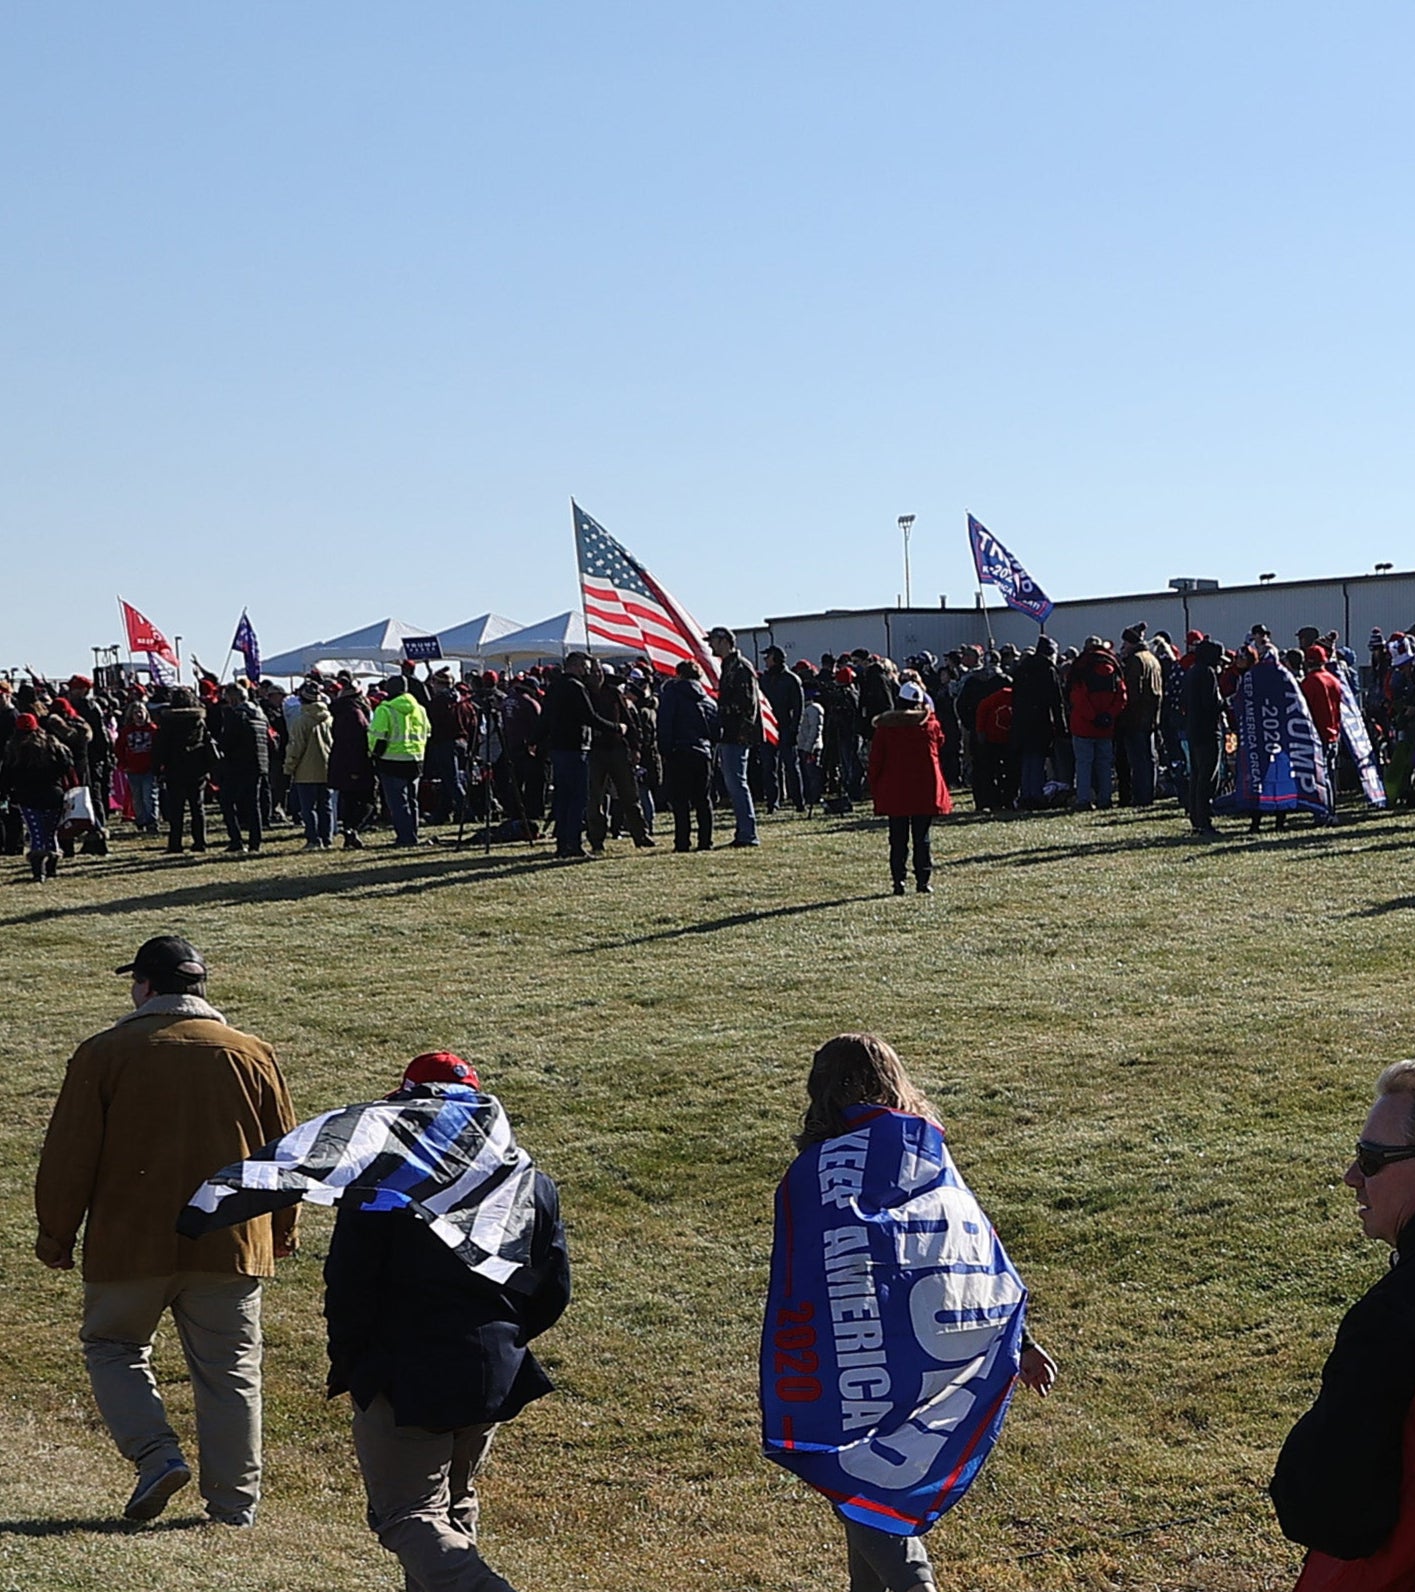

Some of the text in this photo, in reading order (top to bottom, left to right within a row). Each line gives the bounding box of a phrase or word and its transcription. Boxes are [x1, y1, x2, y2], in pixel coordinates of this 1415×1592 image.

[405, 641, 437, 649] TRUMP
[1244, 699, 1257, 753] AMERICA
[816, 1127, 893, 1433] KEEP AMERICA
[774, 1302, 823, 1403] 2020
